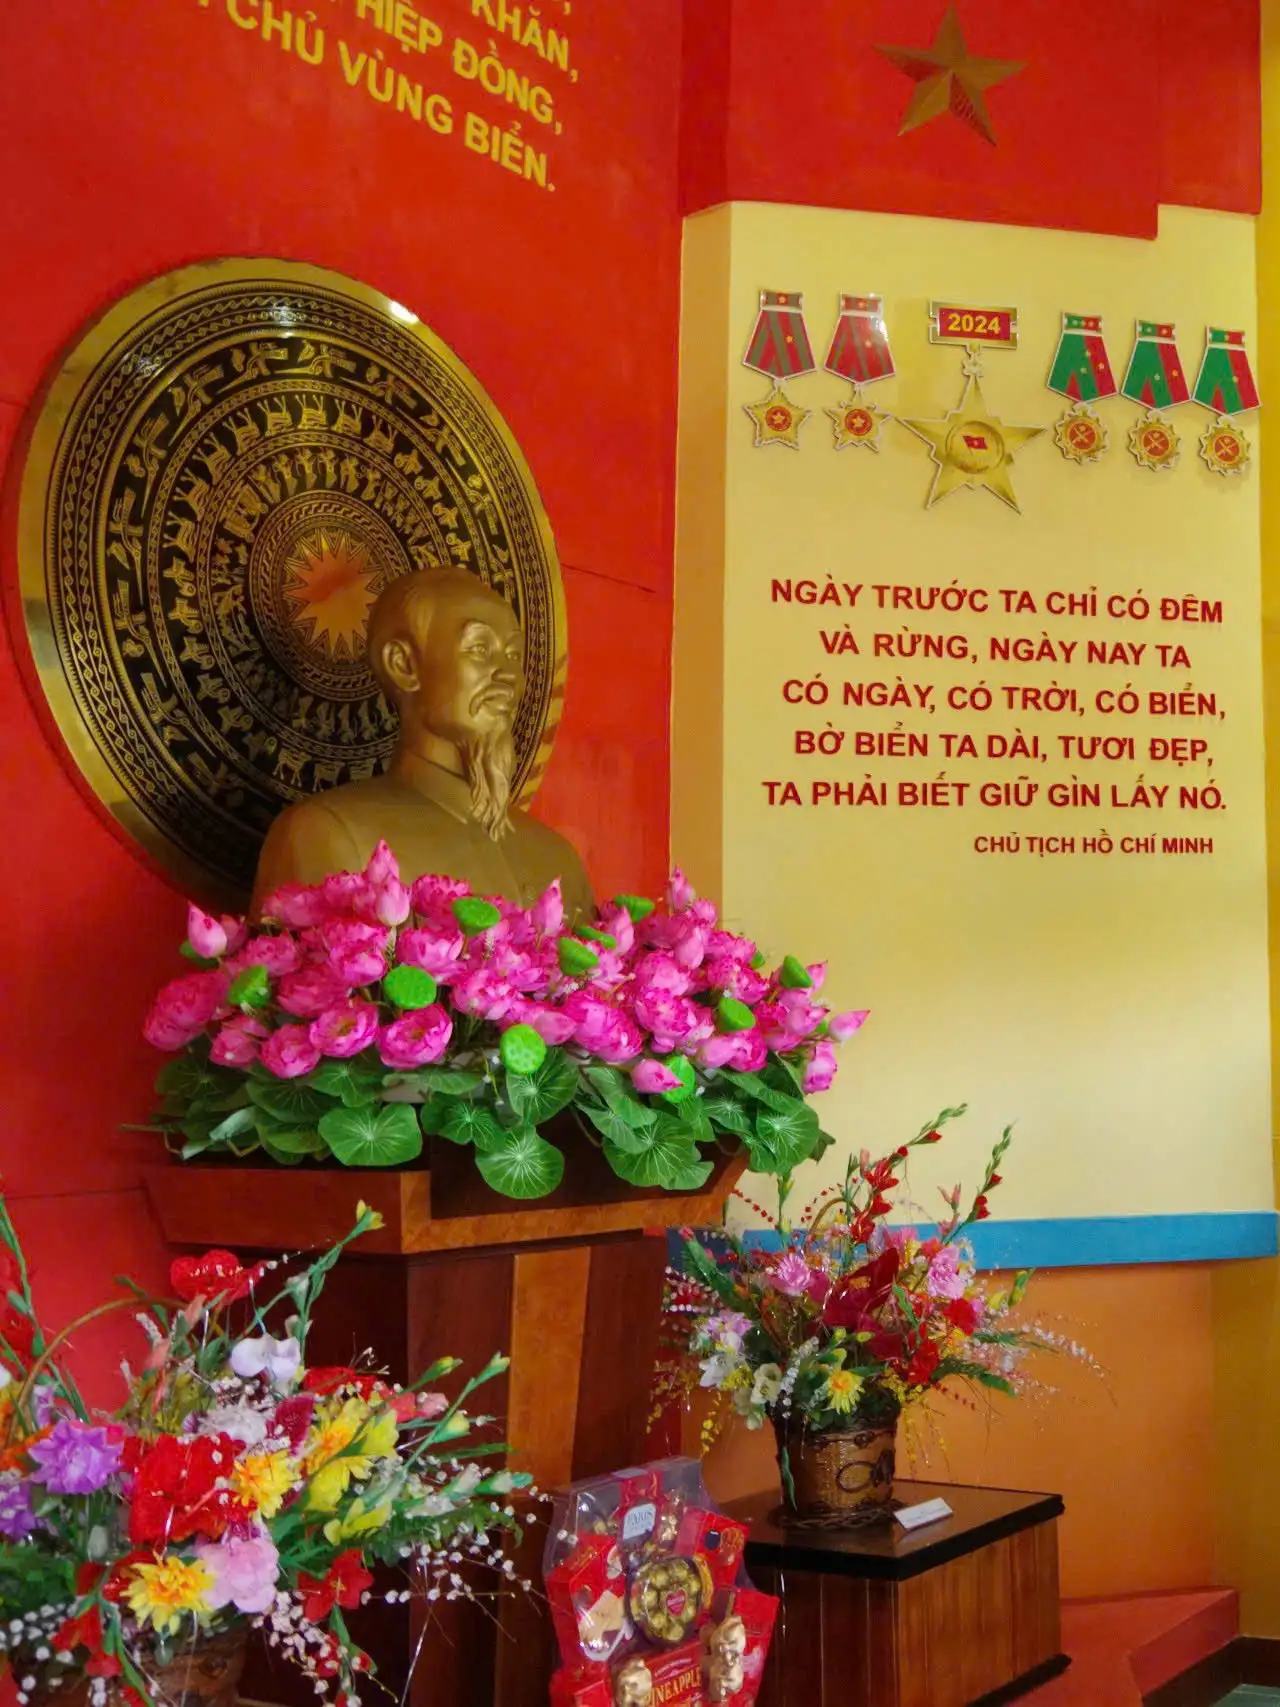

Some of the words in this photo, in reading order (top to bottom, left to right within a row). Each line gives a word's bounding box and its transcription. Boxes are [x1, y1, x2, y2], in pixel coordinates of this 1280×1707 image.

[226, 0, 324, 65] CHỦ
[337, 40, 453, 134] VÙNG
[464, 112, 555, 191] BIỂN.
[452, 38, 562, 135] ĐỒNG,
[948, 312, 1001, 334] 2024
[771, 574, 863, 607] NGÀY
[871, 579, 989, 613] TRƯỚC
[999, 589, 1037, 614] TA
[1045, 586, 1097, 617] CHỈ
[1107, 589, 1150, 620] CÓ
[1159, 592, 1223, 623] ĐÊM
[819, 623, 860, 655] VÀ
[874, 626, 978, 664] RỪNG,
[990, 631, 1078, 664] NGÀY
[1087, 640, 1147, 666] NAY
[1154, 645, 1191, 669] TA
[782, 673, 829, 705] CÓ
[843, 676, 935, 714] NGÀY,
[947, 680, 993, 711] CÓ
[1001, 680, 1085, 716] TRỜI,
[1095, 683, 1140, 715] CÓ
[1149, 682, 1225, 719] BIỂN,
[795, 722, 845, 755] BỜ
[855, 721, 928, 757] BIỂN
[939, 734, 978, 758] TA
[987, 728, 1047, 763] DÀI,
[1057, 735, 1135, 760] TƯƠI
[1149, 737, 1213, 767] ĐẸP,
[762, 781, 803, 806] TA
[812, 773, 887, 806] PHẢI
[898, 771, 970, 807] BIẾT
[979, 775, 1039, 807] GIỮ
[1047, 775, 1101, 808] GÌN
[1111, 773, 1170, 808] LẤY
[1179, 779, 1226, 810] NÓ.
[974, 831, 1020, 853] CHỦ
[1025, 836, 1075, 858] TỊCH
[1082, 829, 1114, 854] HỒ
[1120, 833, 1155, 854] CHÍ
[1162, 837, 1213, 854] MINH
